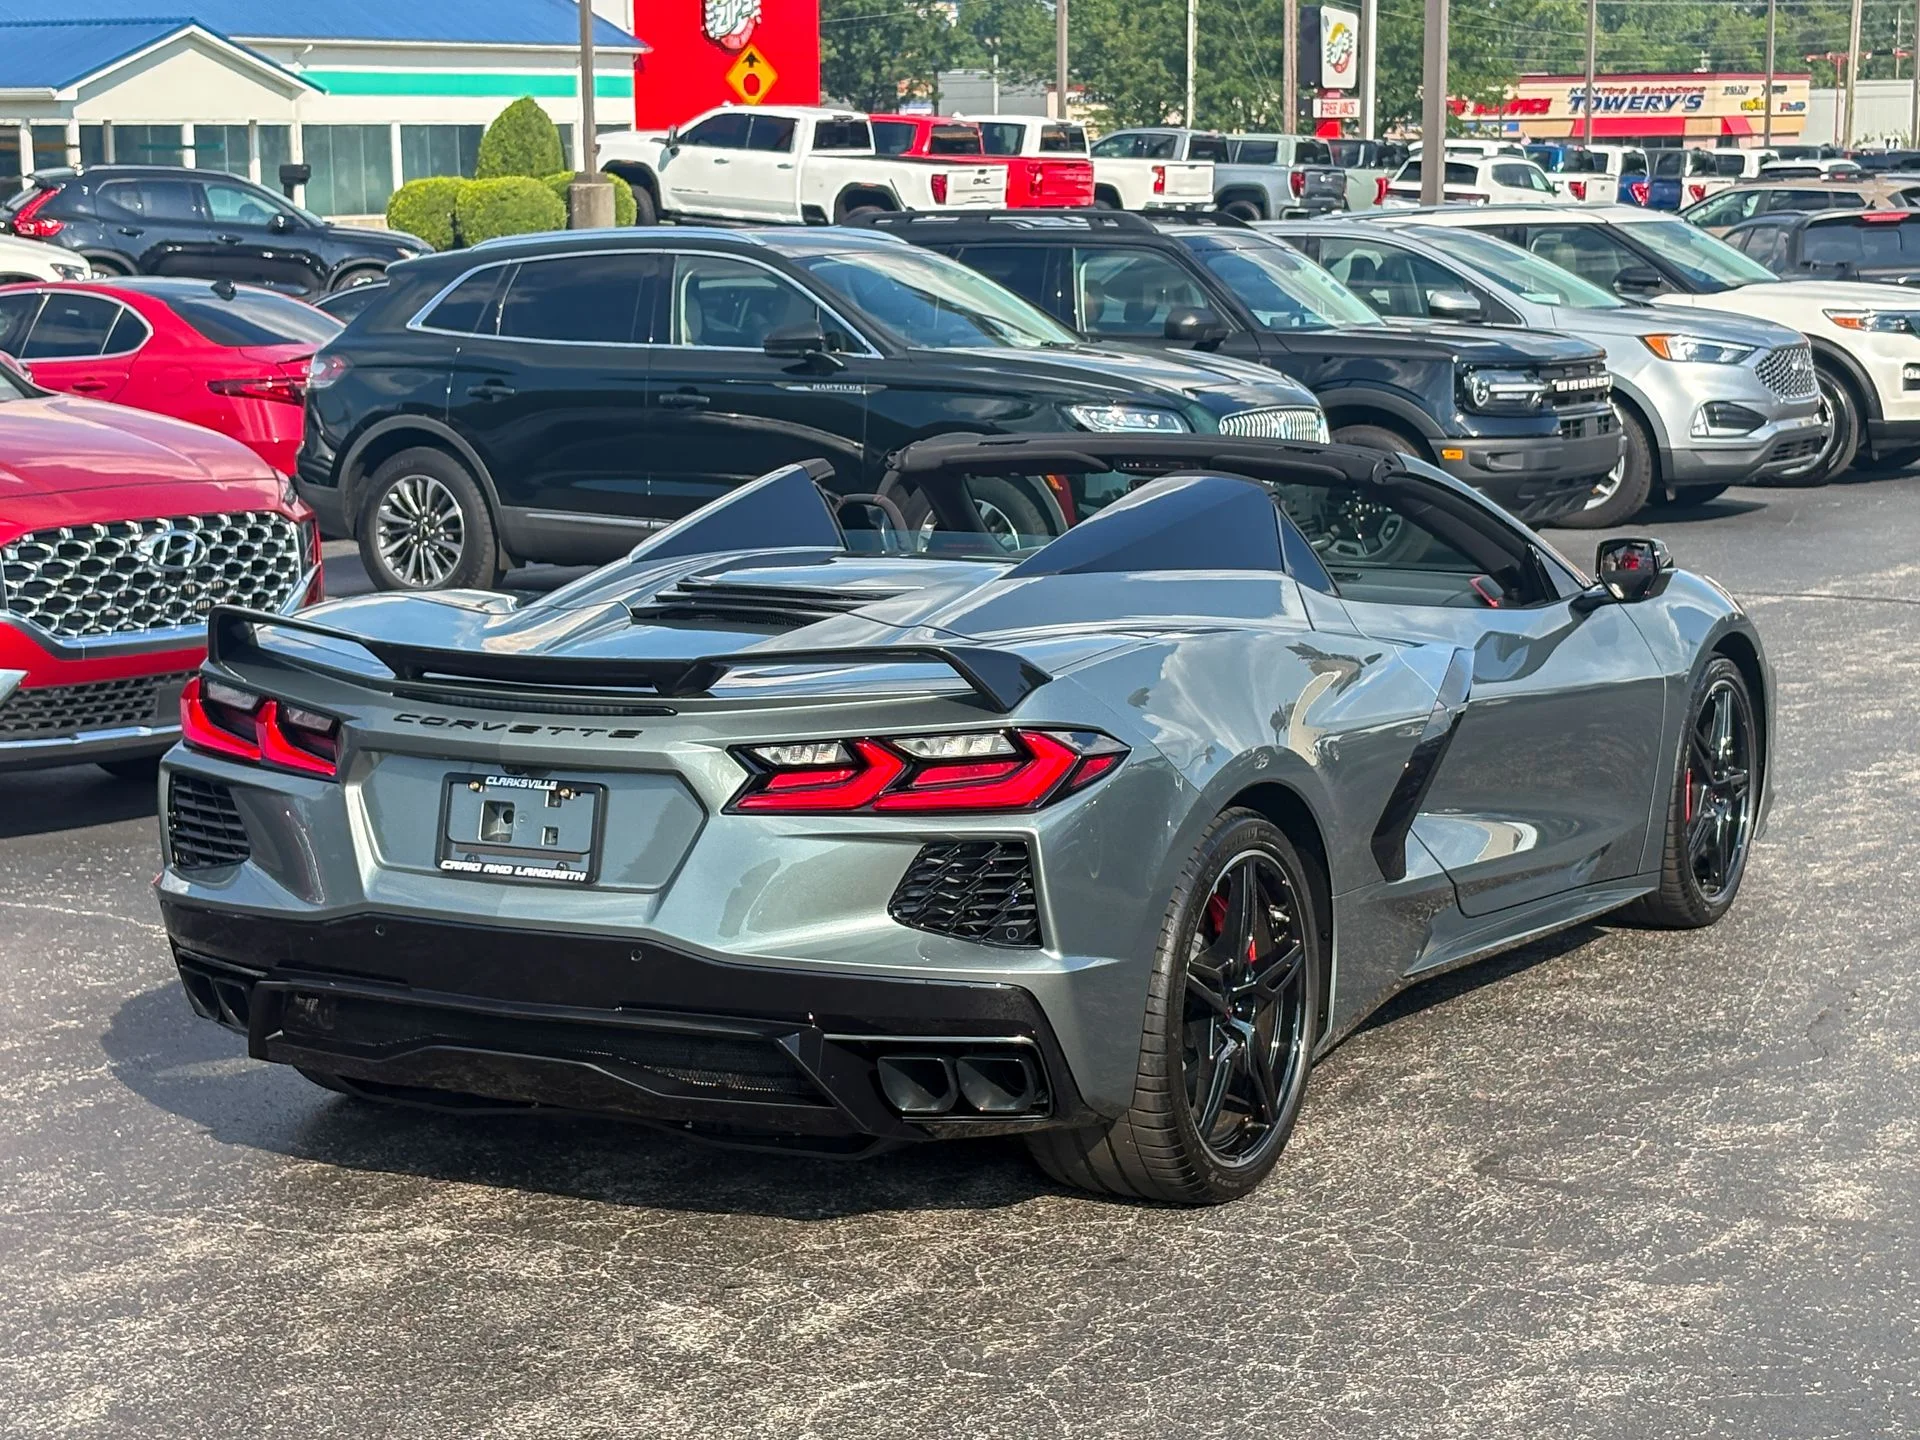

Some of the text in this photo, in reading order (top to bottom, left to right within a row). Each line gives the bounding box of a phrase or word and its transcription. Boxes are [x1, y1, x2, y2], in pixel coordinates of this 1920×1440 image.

[1569, 94, 1704, 113] TOWERY'S
[973, 177, 991, 185] GMC
[812, 384, 862, 392] NAUTILUS
[1556, 376, 1609, 392] BRONCO
[393, 713, 643, 739] CORVETTE
[485, 776, 558, 791] CLARKSVILLE
[440, 860, 587, 881] CRAIG AND LANDRETH
